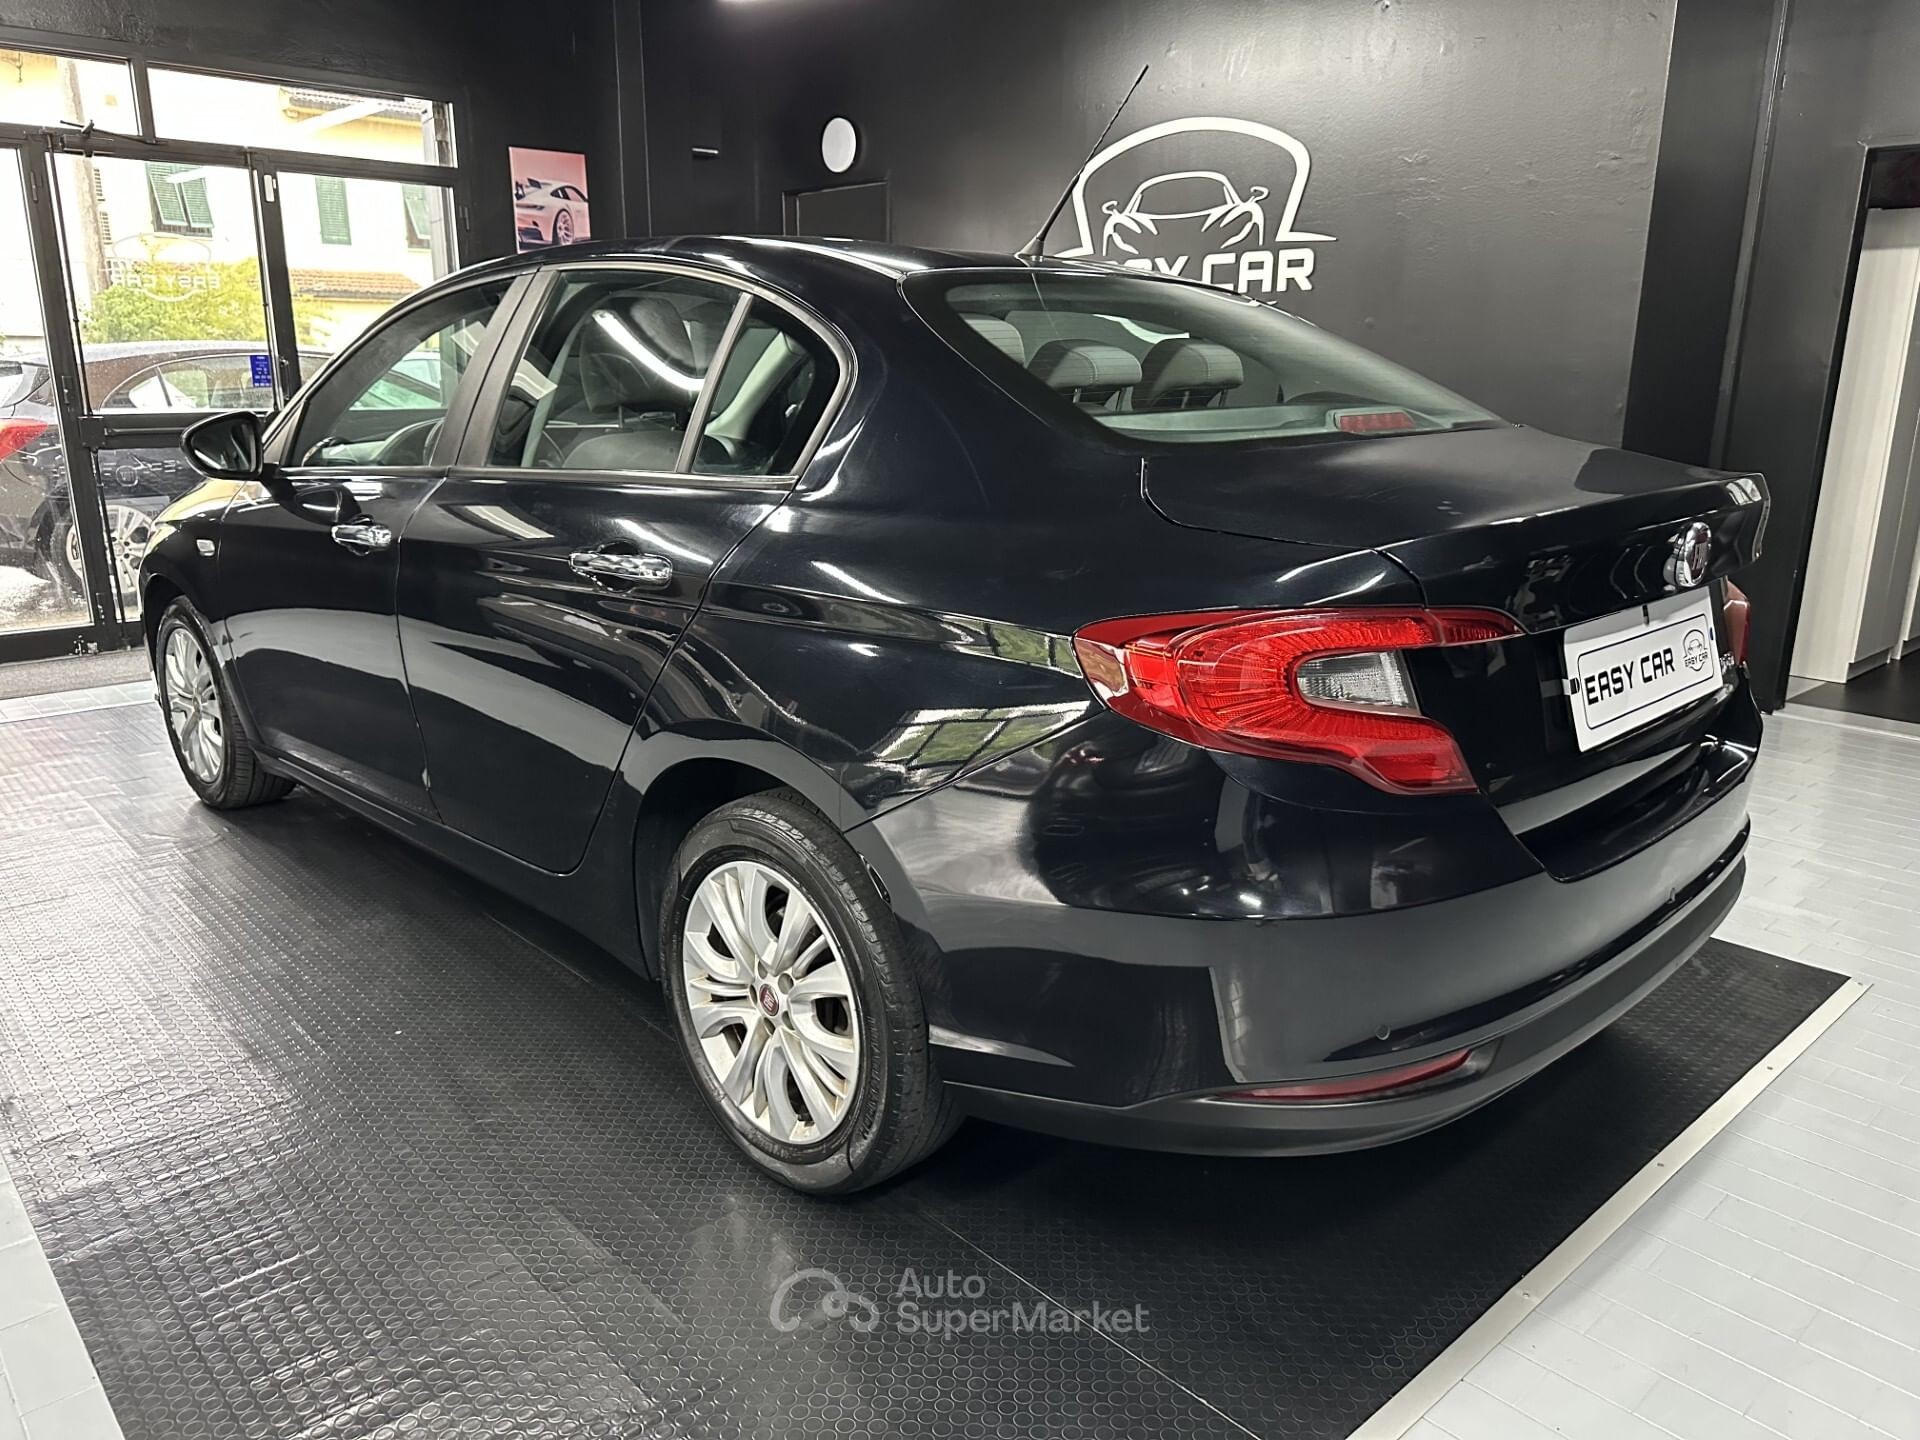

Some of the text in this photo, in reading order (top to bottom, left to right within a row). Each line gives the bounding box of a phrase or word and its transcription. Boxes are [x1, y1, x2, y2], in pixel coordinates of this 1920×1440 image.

[1202, 248, 1315, 295] CAR
[1584, 661, 1634, 706] EASY
[1640, 647, 1676, 684] CAR
[1684, 656, 1698, 668] EASY
